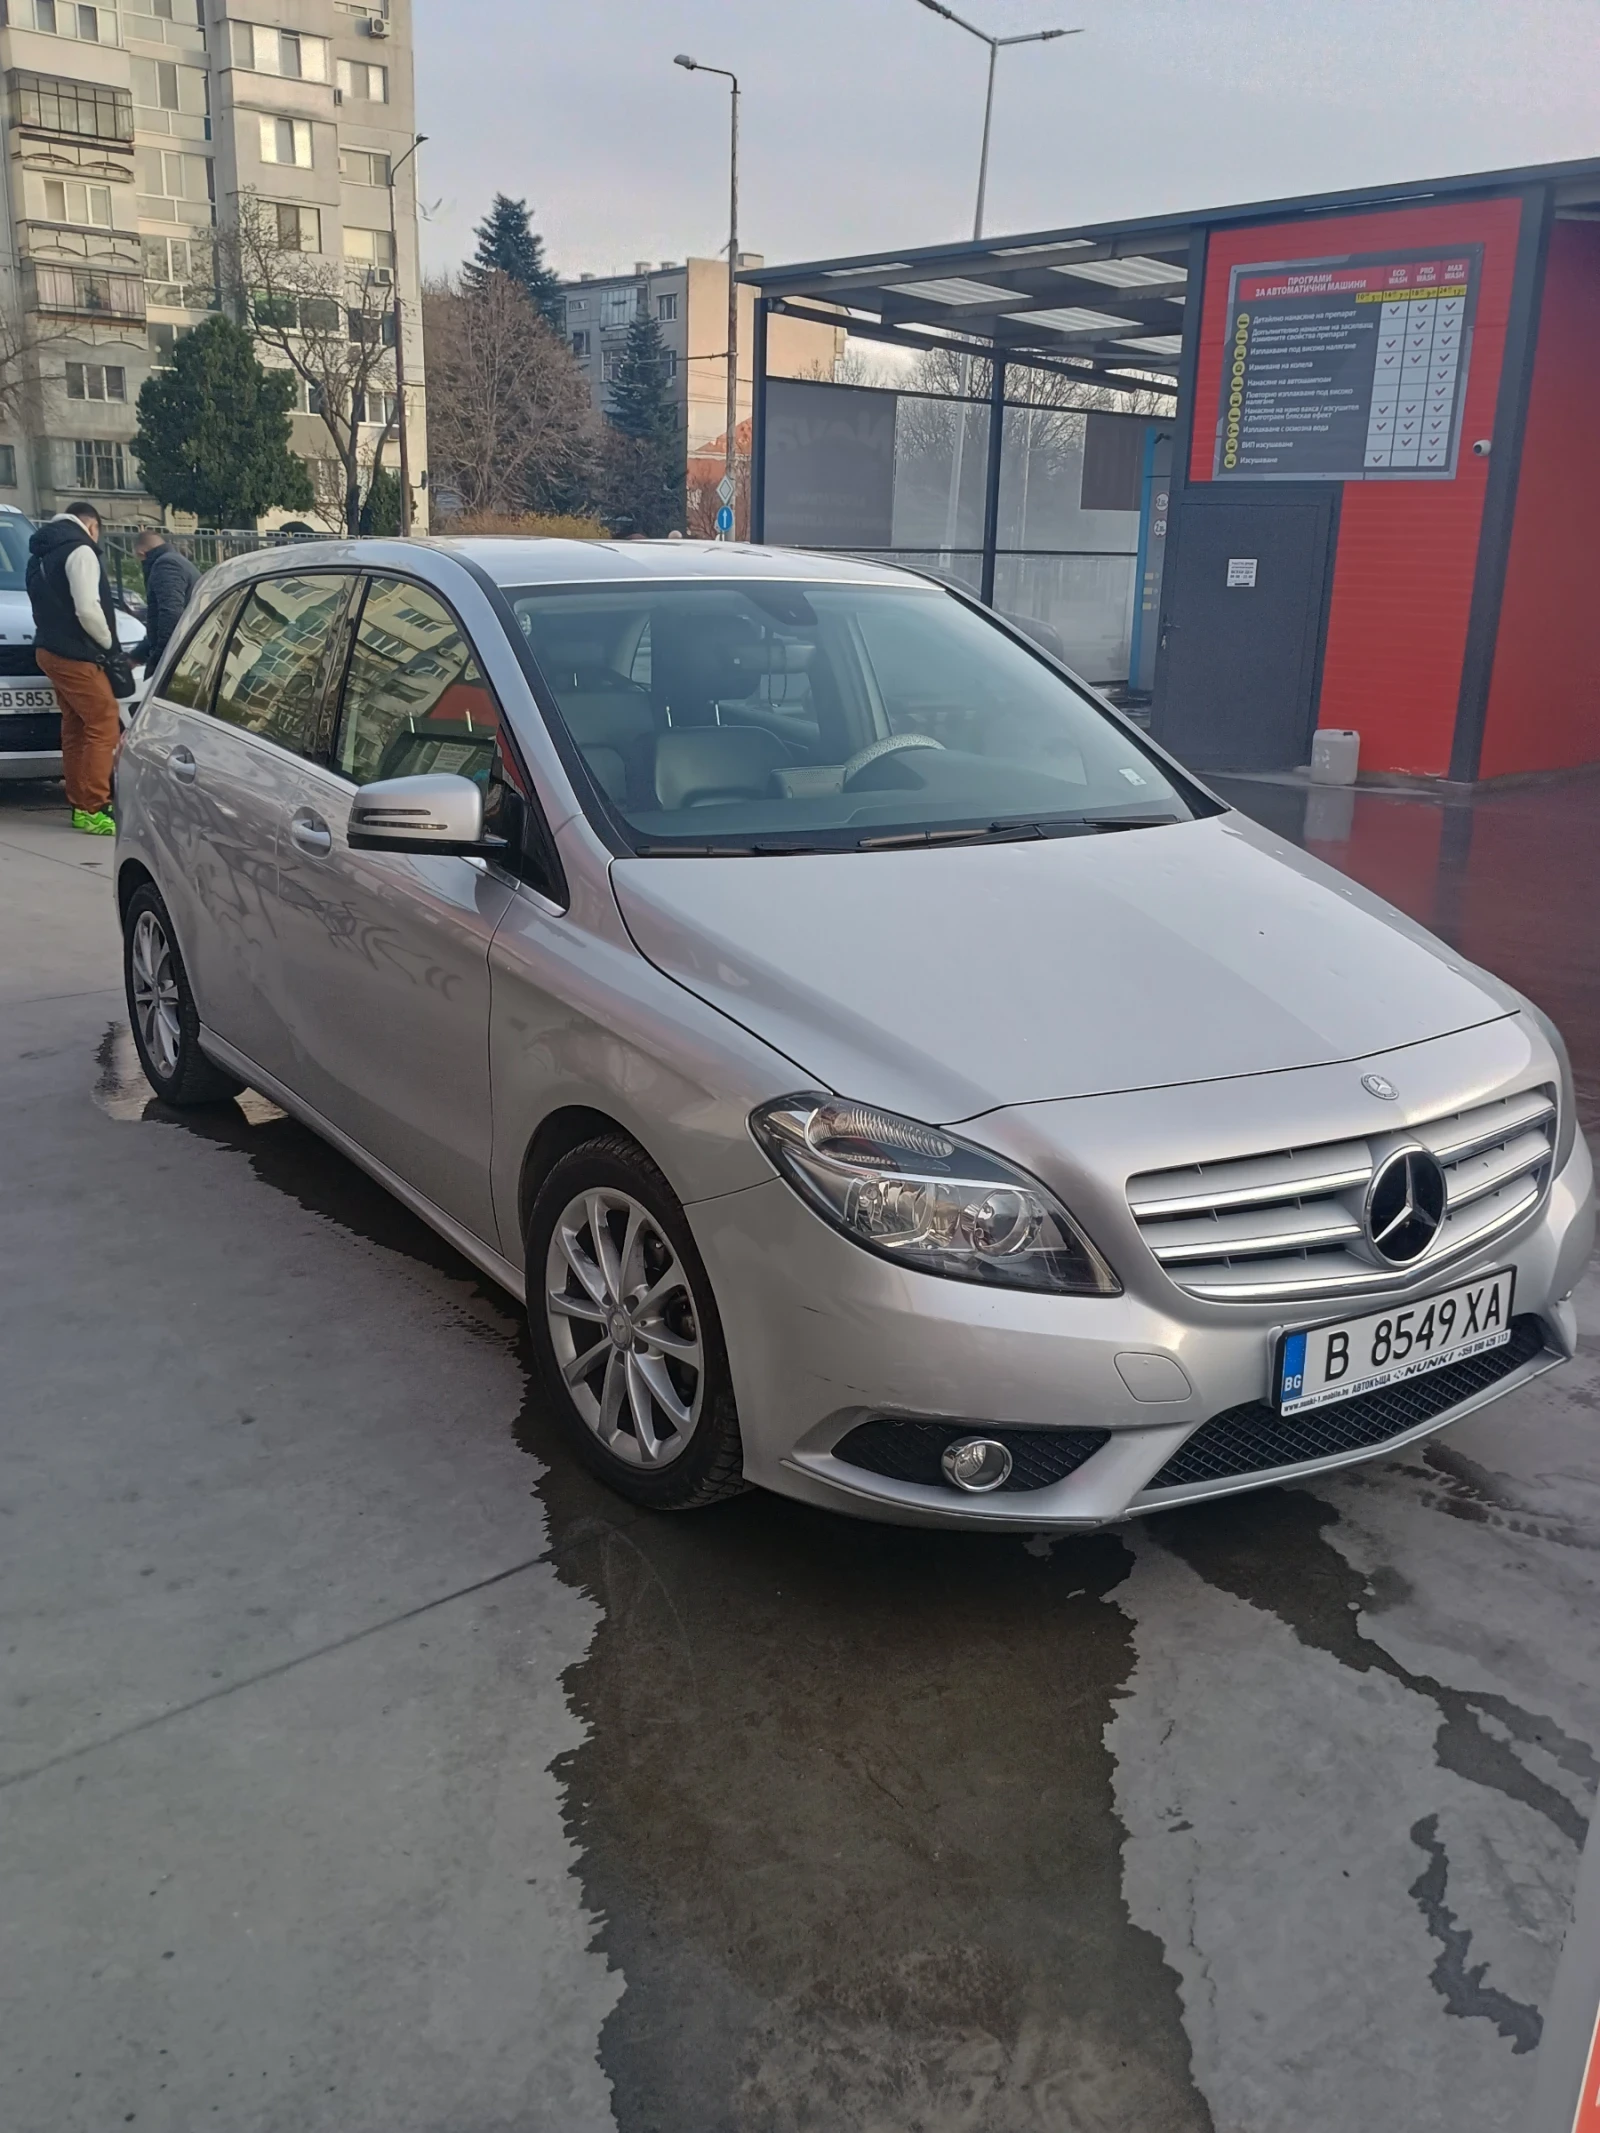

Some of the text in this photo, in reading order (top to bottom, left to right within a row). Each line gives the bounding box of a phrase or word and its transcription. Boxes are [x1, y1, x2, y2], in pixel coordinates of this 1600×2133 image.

[1288, 274, 1332, 285] ПРОГРАМИ
[1389, 276, 1408, 284] WASH
[1416, 273, 1436, 282] WASH
[1445, 271, 1464, 280] WASH
[1256, 280, 1366, 297] ЗА АВТОМАТИЧНИ МАШИНИ
[1253, 316, 1283, 325] Детайлно
[1325, 310, 1356, 319] препарат
[1317, 331, 1348, 339] препарат
[1313, 412, 1332, 420] ефект
[0, 692, 53, 707] B 5853
[1325, 1283, 1500, 1382] B 8549 XA
[1352, 1374, 1391, 1394] АВТОКЪЩА
[1405, 1352, 1454, 1376] NUNKI
[1284, 1374, 1302, 1392] BG
